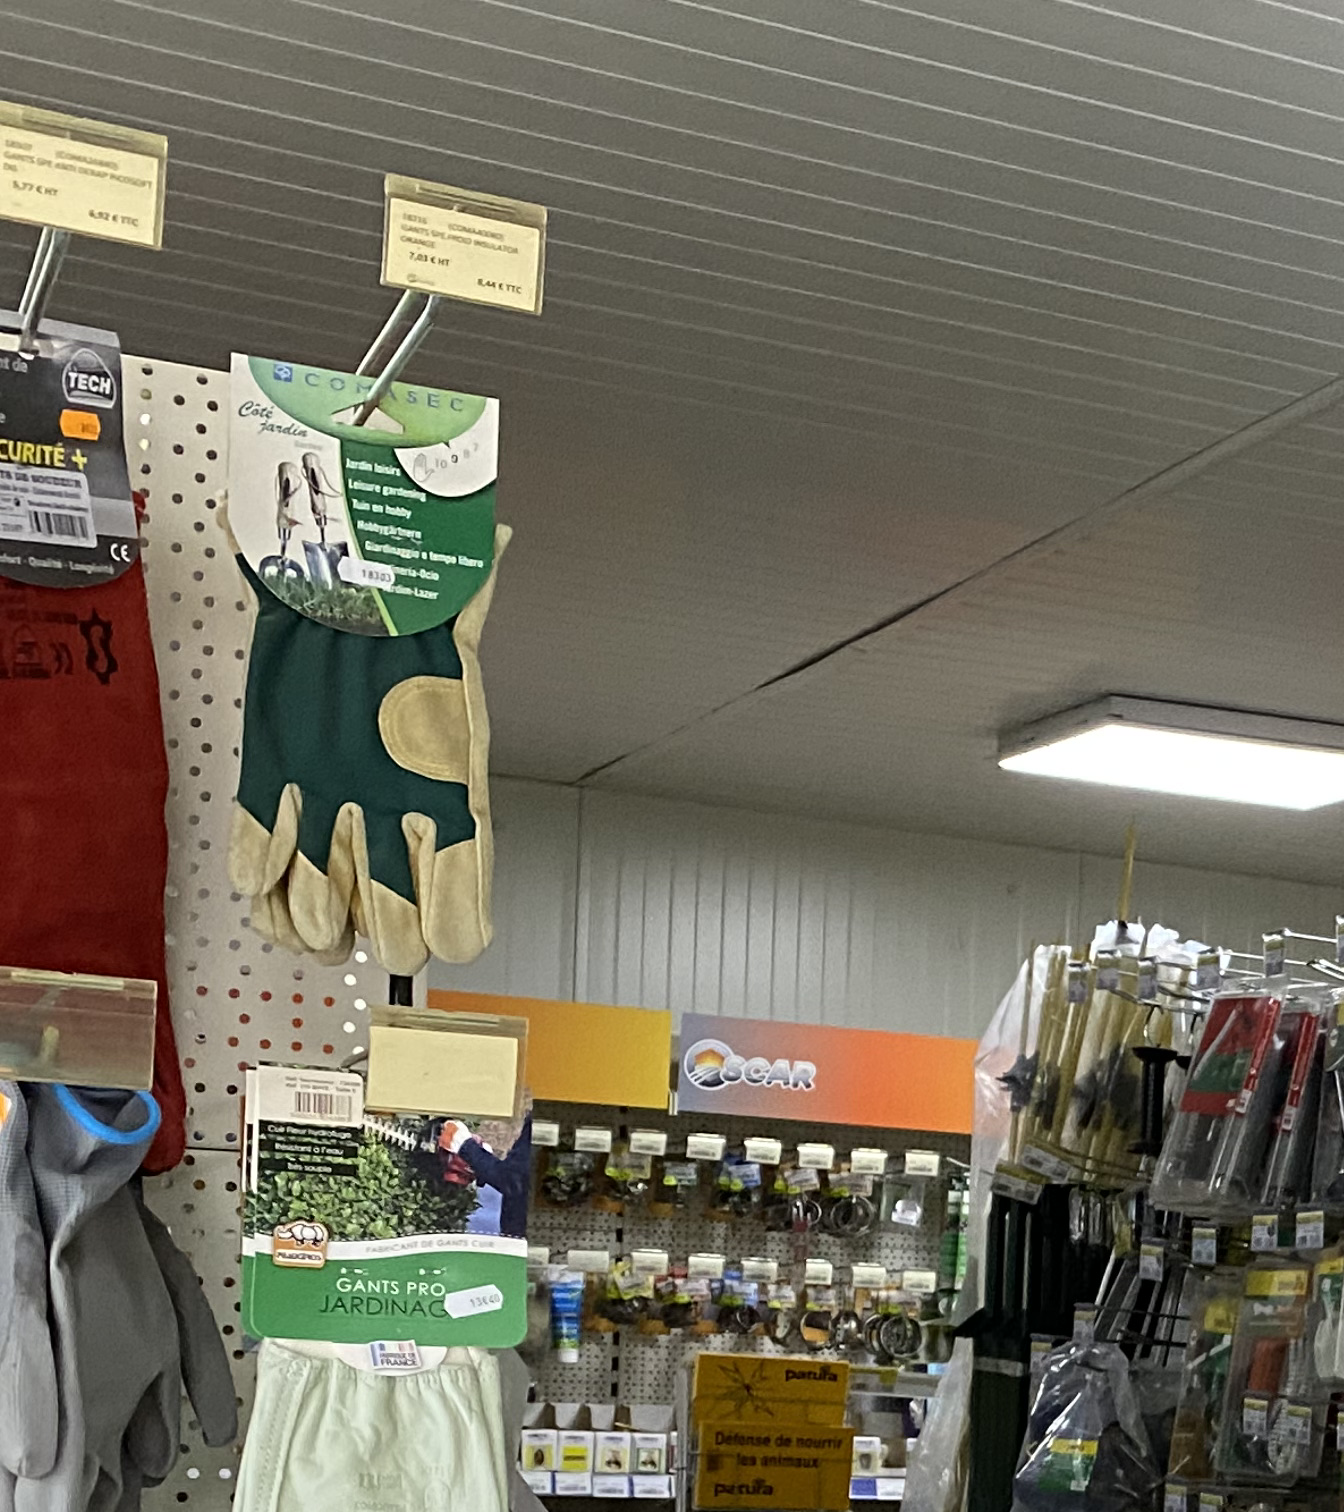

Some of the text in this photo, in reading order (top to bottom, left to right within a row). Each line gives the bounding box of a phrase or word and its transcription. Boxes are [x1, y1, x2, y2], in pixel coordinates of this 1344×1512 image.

[119, 216, 139, 227] TTC
[438, 258, 450, 266] HT
[506, 284, 521, 294] TTC
[68, 371, 111, 394] TECH
[238, 400, 308, 438] Côté jardin
[451, 454, 458, 464] 9
[421, 1239, 434, 1248] DE
[436, 1238, 469, 1248] GANTS
[336, 1277, 446, 1298] GANTS PRO
[320, 1295, 448, 1319] JARDINAG
[380, 1358, 419, 1368] FRANCE
[775, 1434, 791, 1446] de
[796, 1436, 843, 1450] nourrir
[761, 1456, 820, 1468] animaux
[714, 1482, 773, 1497] patura
